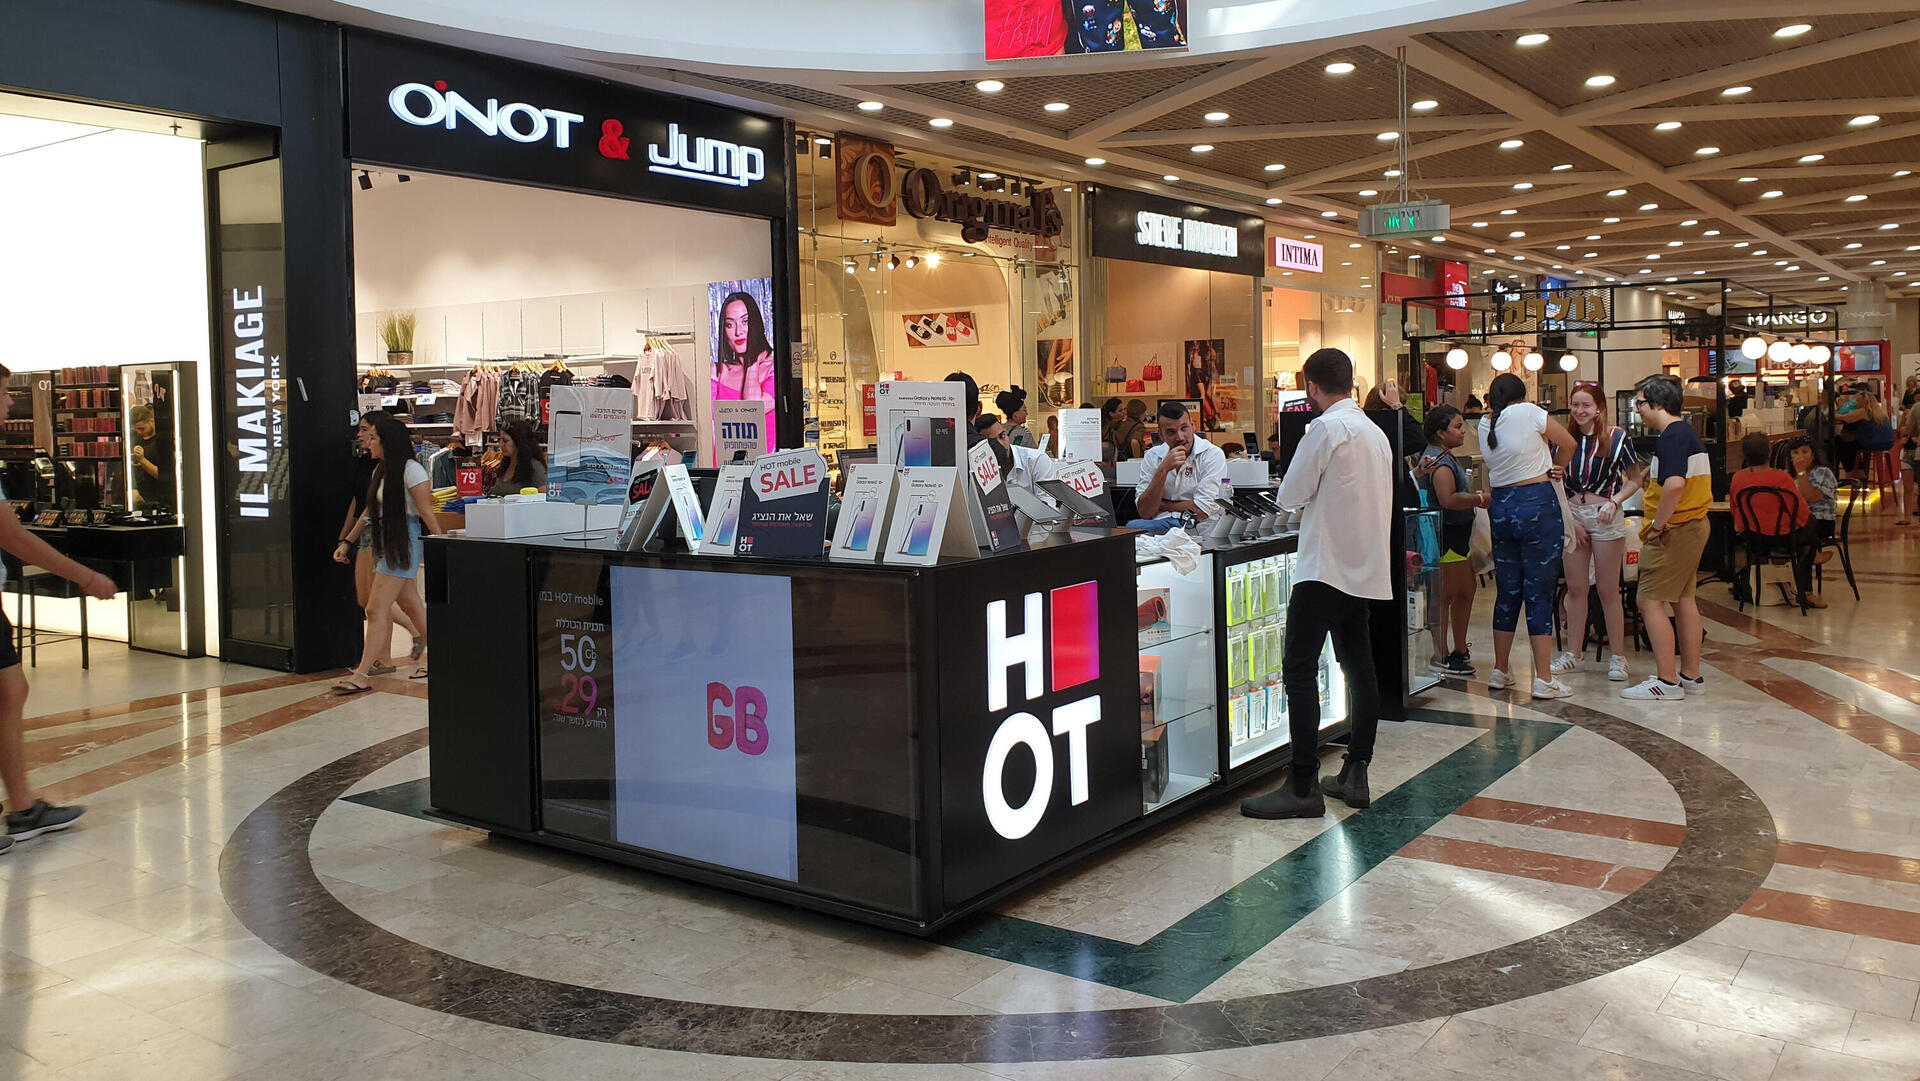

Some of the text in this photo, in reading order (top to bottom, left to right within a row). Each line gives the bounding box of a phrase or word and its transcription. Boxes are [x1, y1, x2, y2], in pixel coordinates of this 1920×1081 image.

[599, 118, 631, 161] &
[648, 122, 765, 187] Jump
[902, 168, 1063, 244] Originals
[1137, 210, 1183, 250] STEVE
[1281, 243, 1319, 267] INTIMA
[1503, 289, 1607, 328] גולדה
[1746, 310, 1828, 326] MANGO
[233, 285, 270, 518] IL MAKIAGE
[270, 354, 283, 448] NEW YORK
[721, 422, 758, 439] תודה
[760, 462, 775, 471] HOT
[777, 458, 801, 467] mobile
[760, 464, 817, 493] SALE
[977, 456, 999, 487] SALE
[752, 511, 814, 521] שאל את הנציג
[555, 592, 573, 603] HOT
[575, 594, 604, 606] mobile
[583, 621, 605, 632] תכנית
[706, 681, 769, 756] GB
